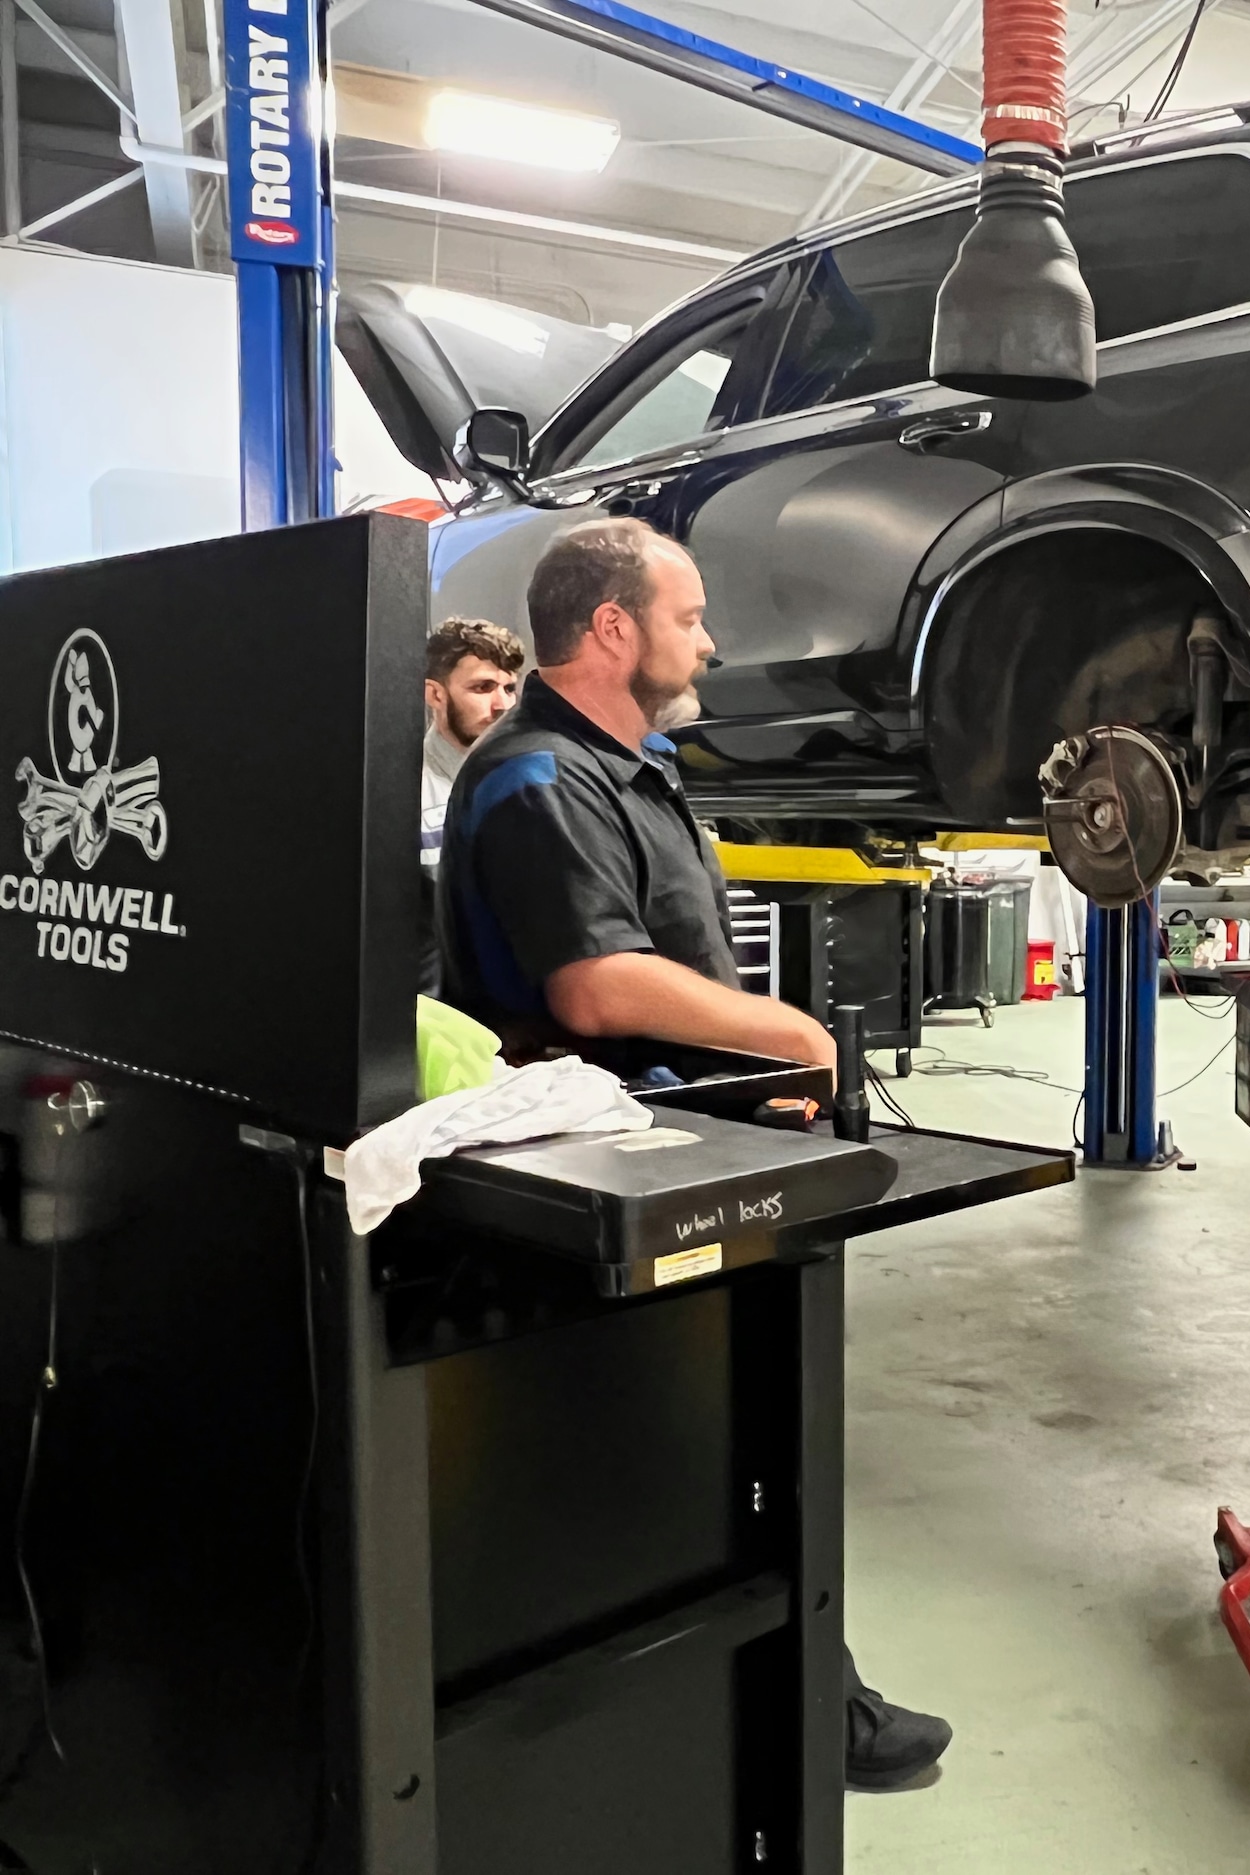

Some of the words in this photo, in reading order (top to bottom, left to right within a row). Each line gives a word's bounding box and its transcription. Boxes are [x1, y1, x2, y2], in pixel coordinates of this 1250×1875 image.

[248, 24, 291, 219] ROTARY
[0, 873, 179, 935] CORNWELL
[36, 921, 130, 973] TOOLS
